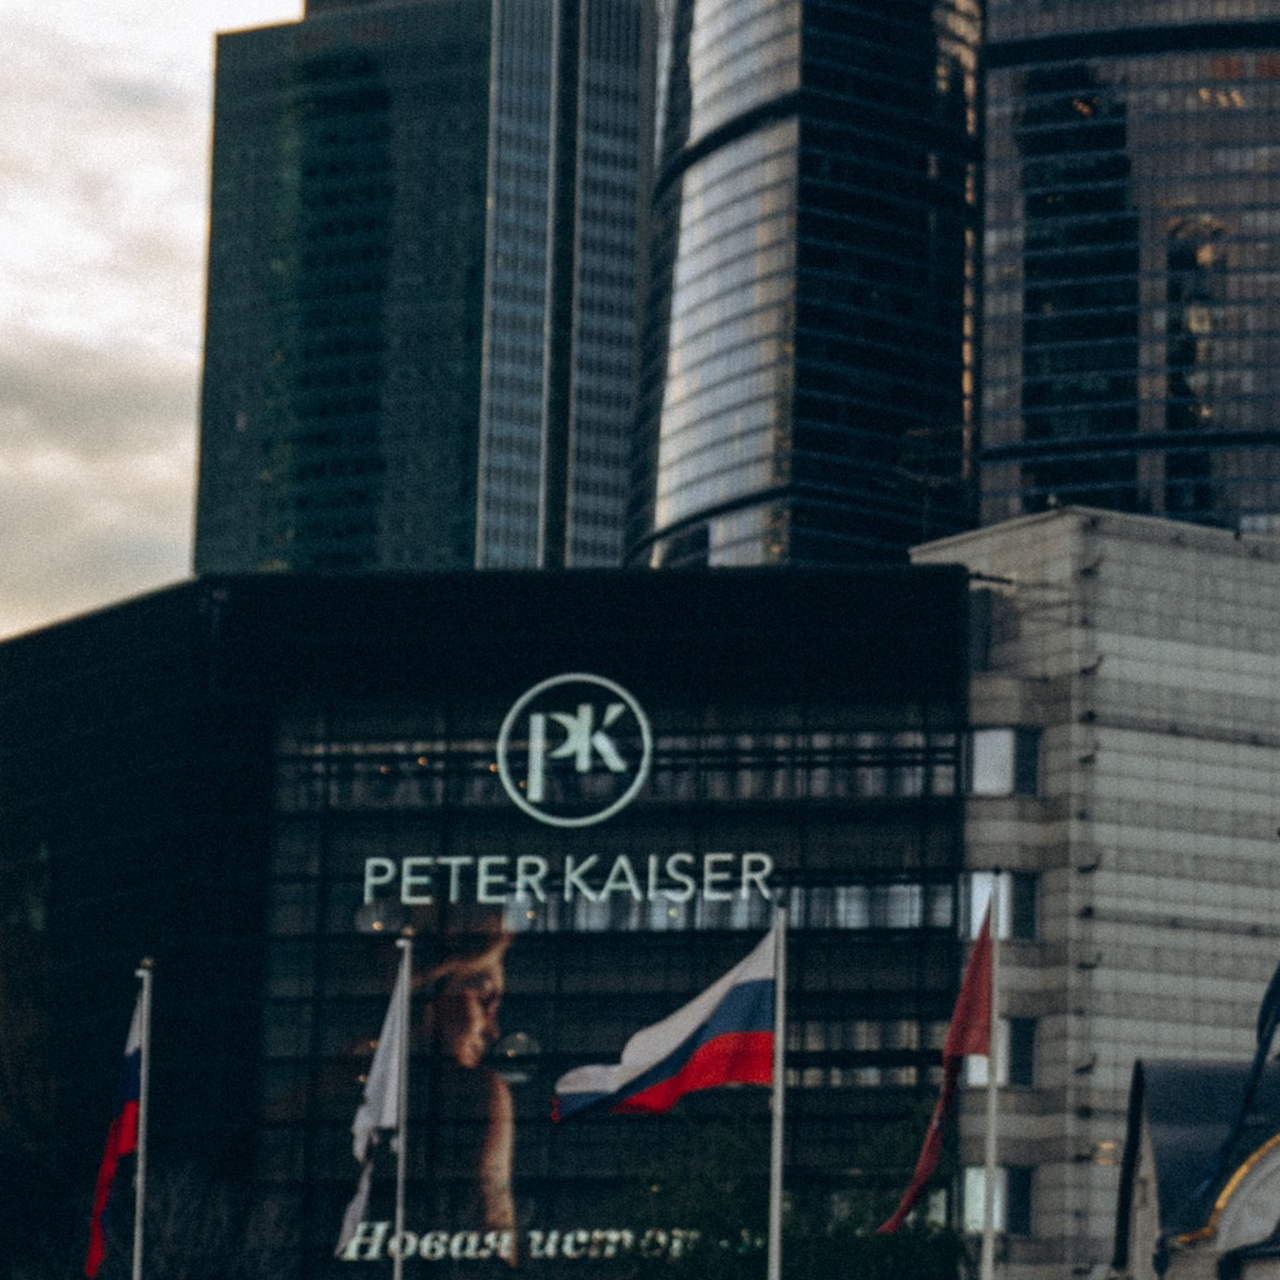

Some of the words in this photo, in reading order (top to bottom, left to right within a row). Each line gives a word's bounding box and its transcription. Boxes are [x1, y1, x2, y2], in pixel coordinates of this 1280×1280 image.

[363, 856, 550, 906] PETER
[563, 852, 774, 904] KAISER
[345, 1220, 514, 1261] Новая
